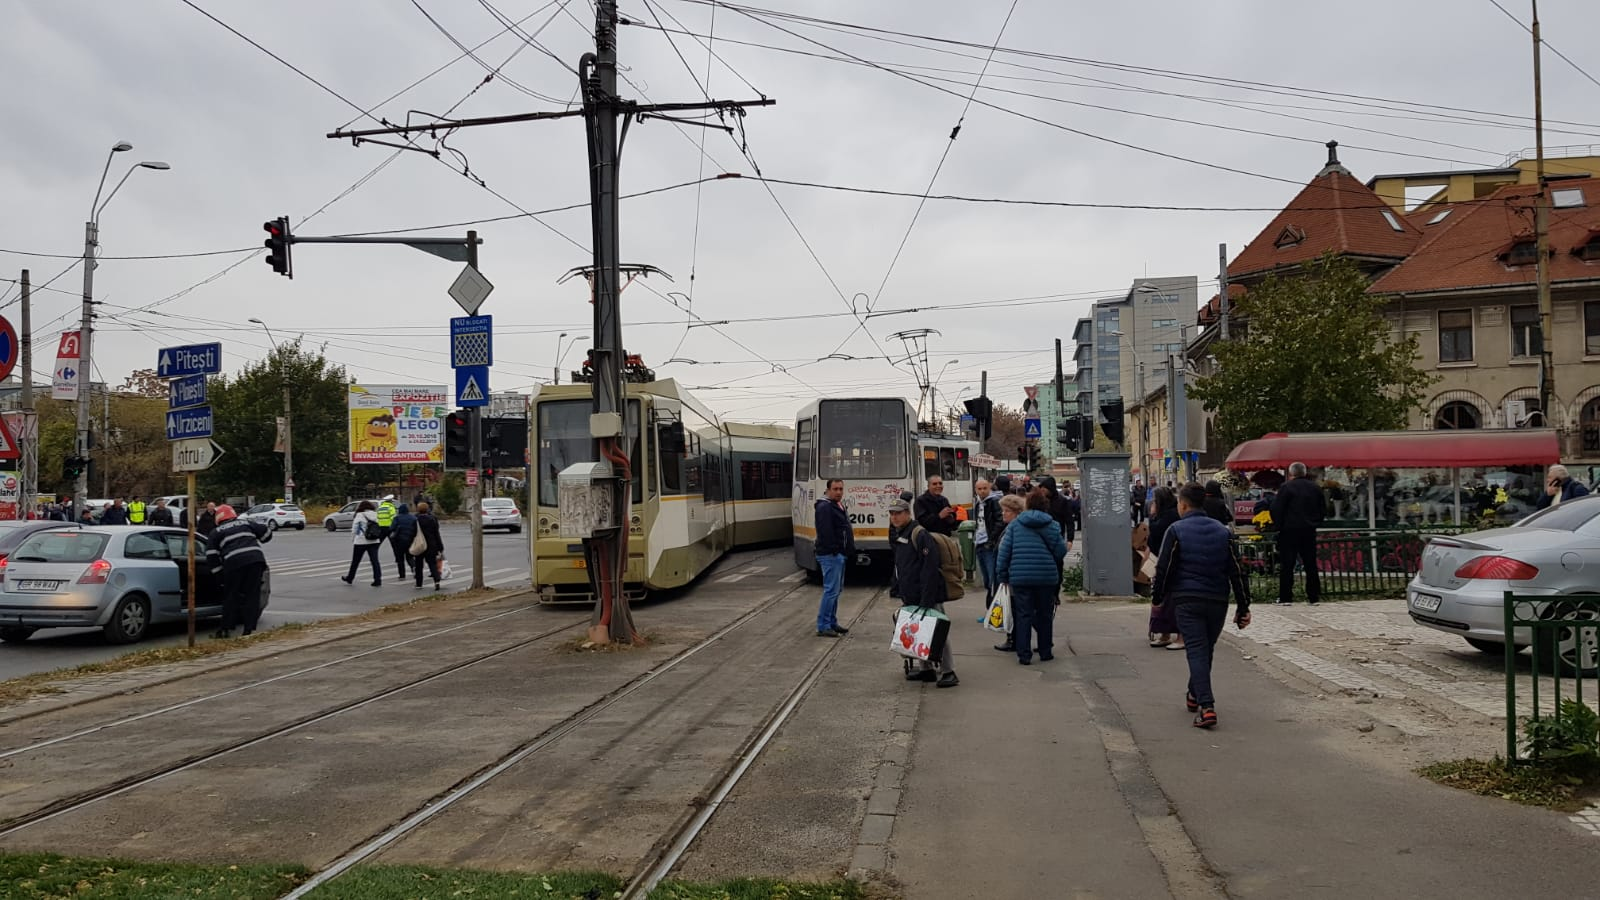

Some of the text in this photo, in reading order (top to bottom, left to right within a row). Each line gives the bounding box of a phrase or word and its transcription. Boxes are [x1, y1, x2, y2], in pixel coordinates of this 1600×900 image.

[393, 404, 447, 419] PIESE
[176, 411, 211, 434] Urziceni
[399, 420, 438, 430] LEGO
[849, 513, 875, 524] 206
